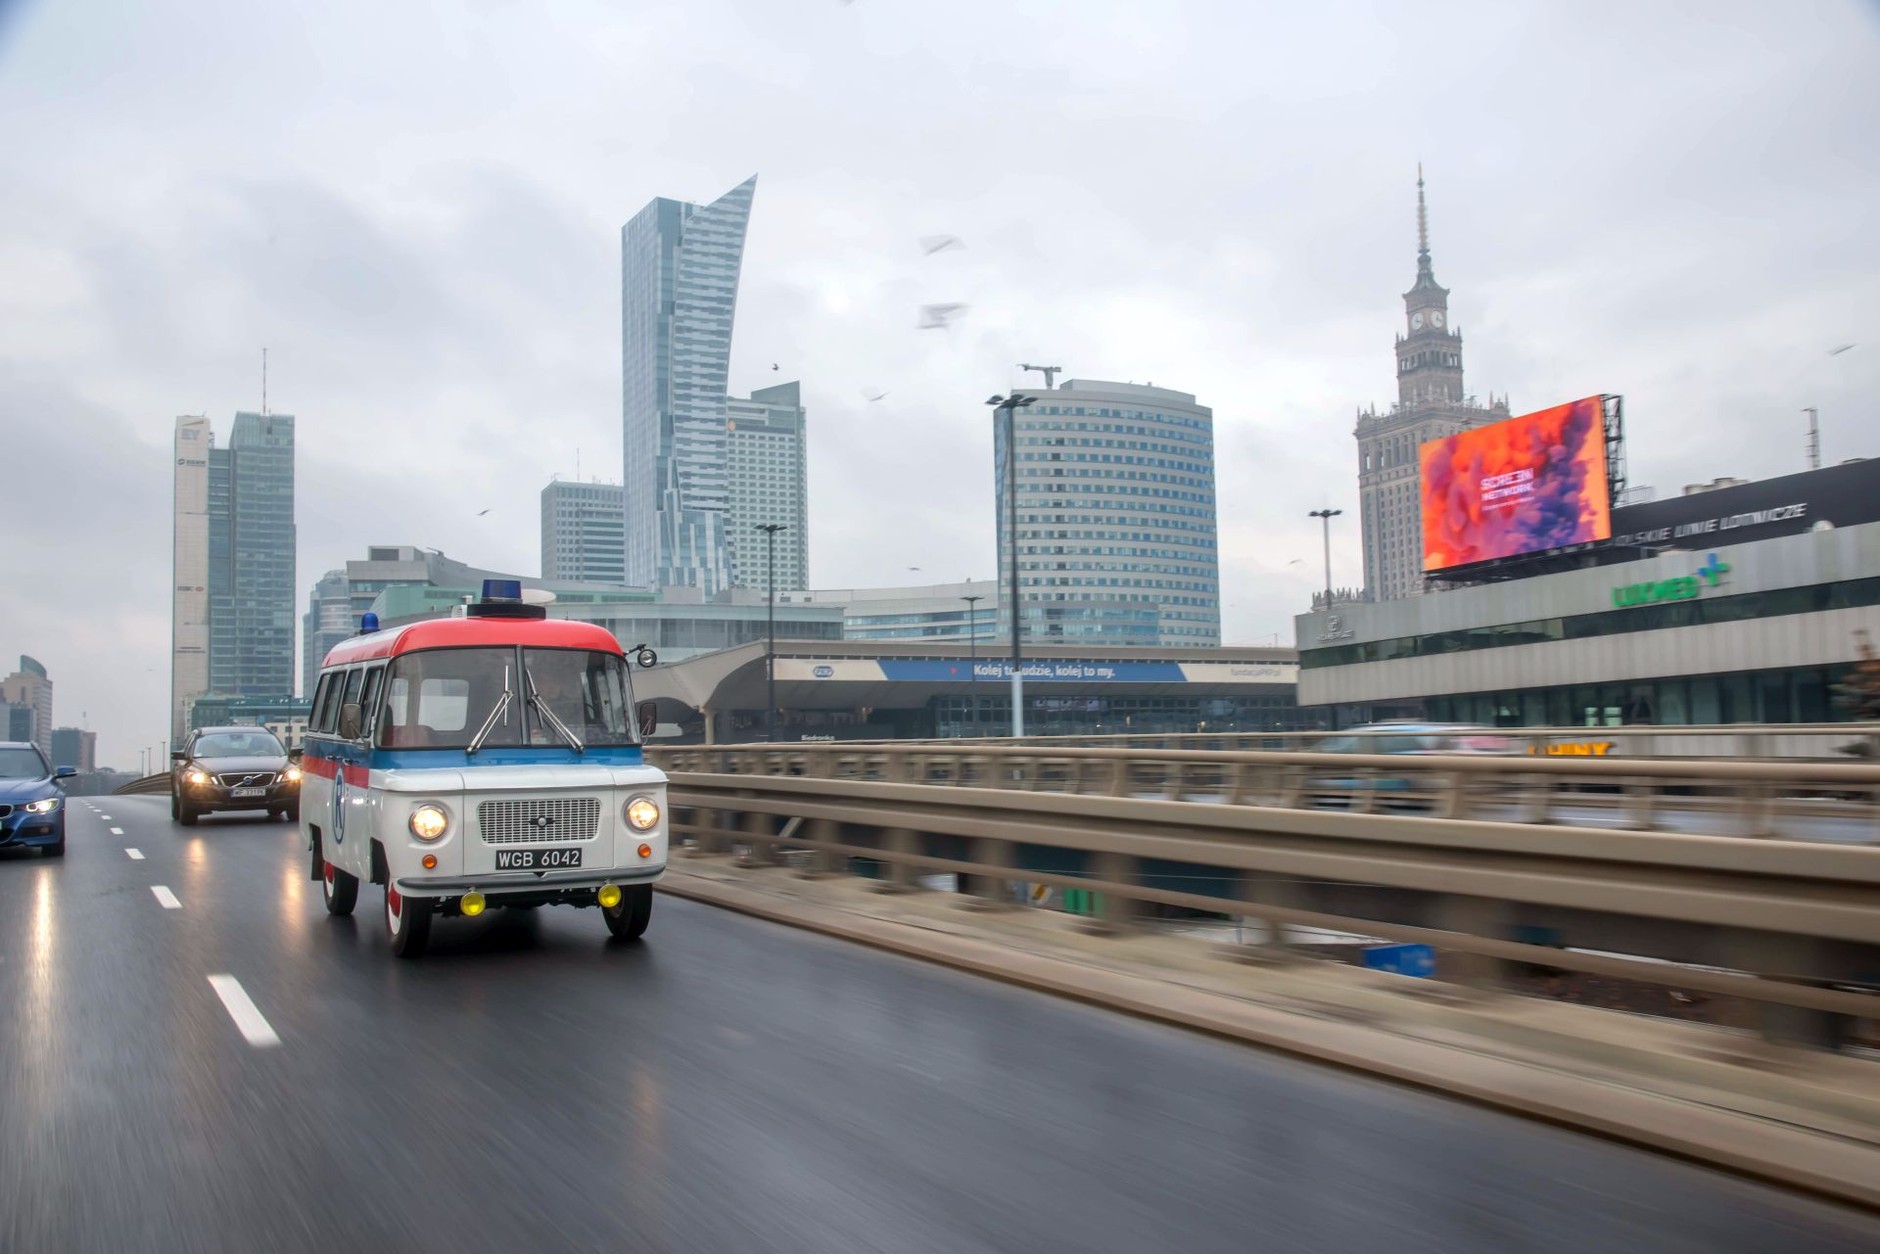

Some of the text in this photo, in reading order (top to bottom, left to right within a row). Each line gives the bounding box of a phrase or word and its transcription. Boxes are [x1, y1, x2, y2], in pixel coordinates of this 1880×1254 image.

[974, 664, 1002, 677] Kolej
[1055, 664, 1081, 678] kolej
[1084, 665, 1096, 676] to
[1097, 667, 1116, 679] my.
[499, 850, 580, 868] WGB 6042
